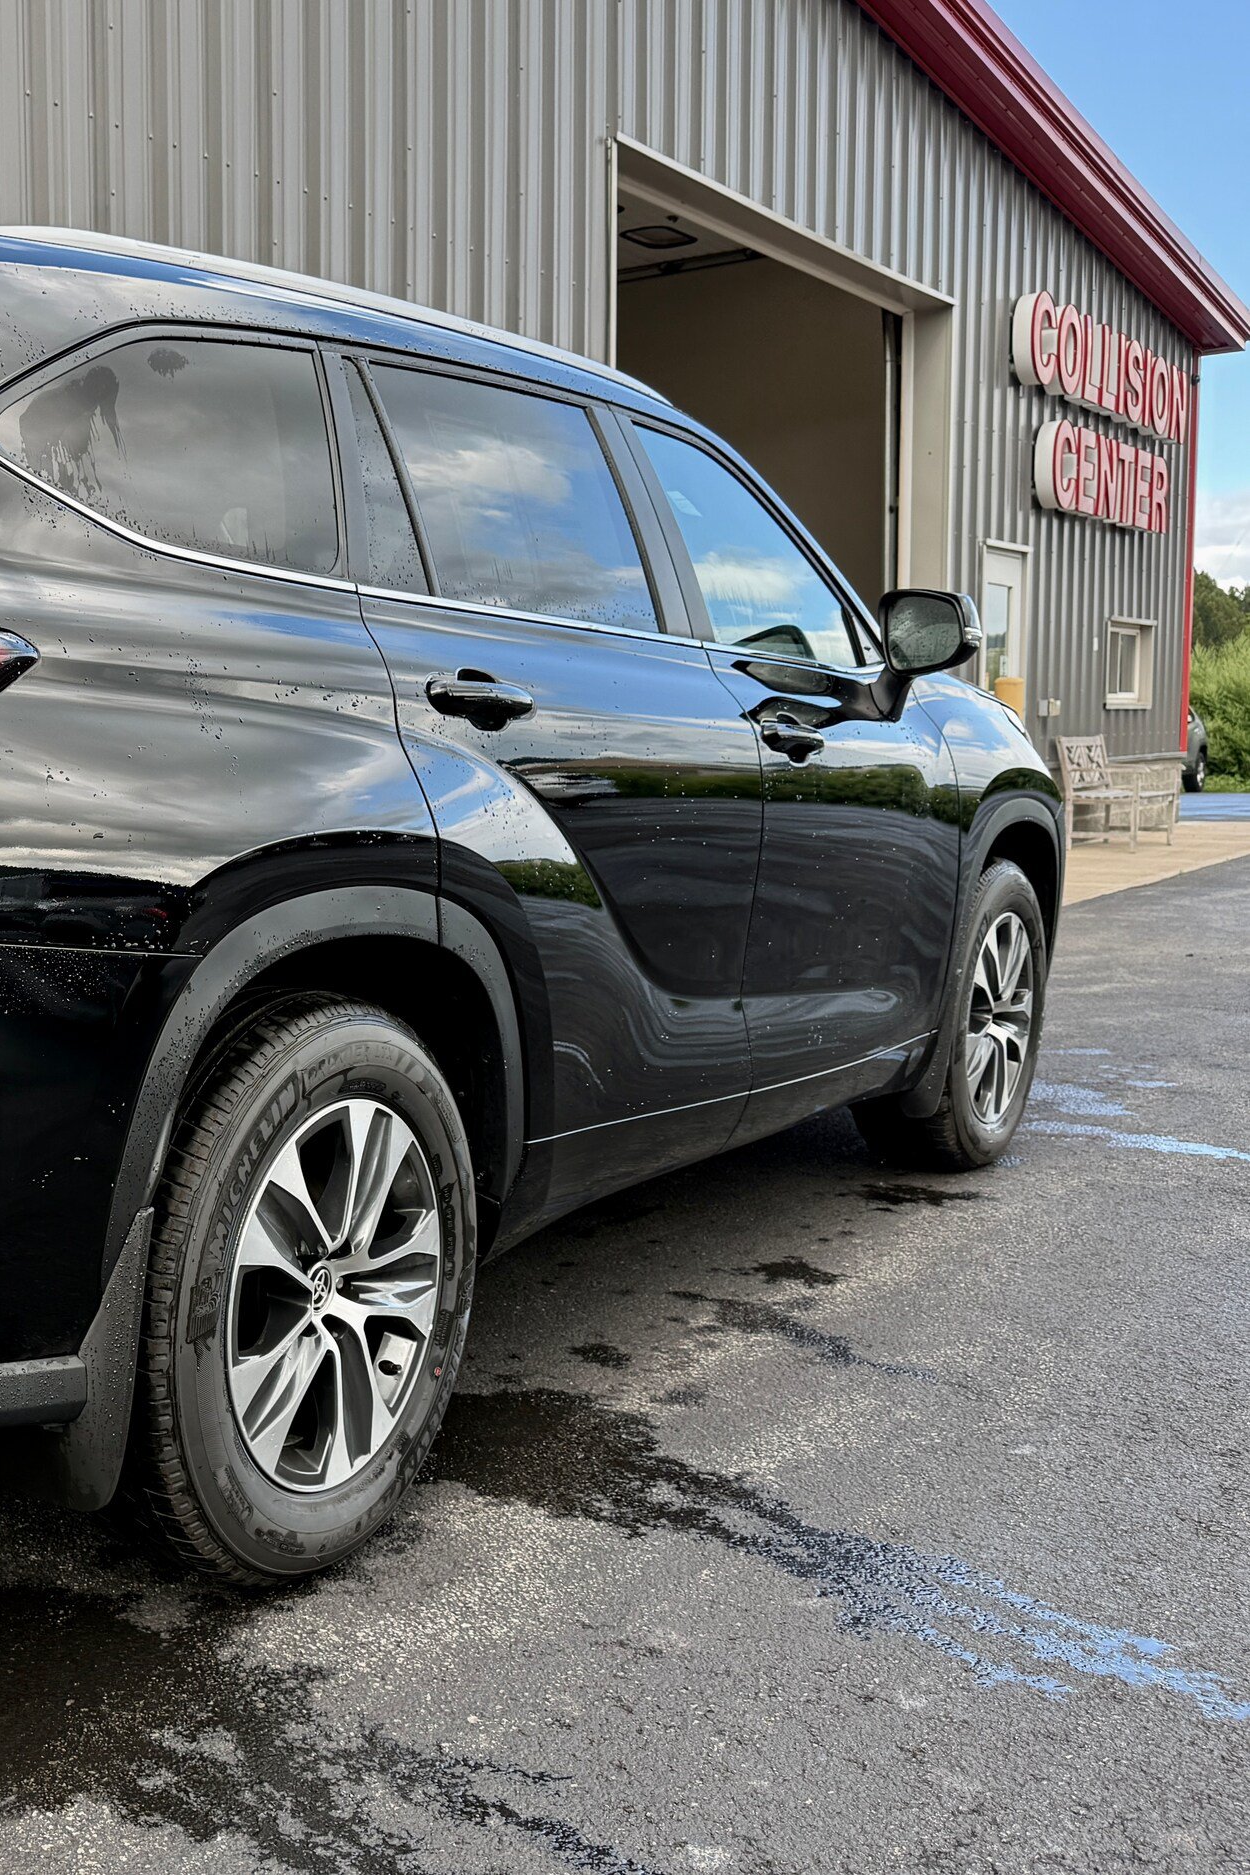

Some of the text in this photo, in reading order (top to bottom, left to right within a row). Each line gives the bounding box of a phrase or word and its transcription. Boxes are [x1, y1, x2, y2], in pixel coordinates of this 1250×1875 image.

[1031, 290, 1187, 445] COLLISION
[1053, 419, 1169, 534] CENTER
[209, 1080, 297, 1262] MICHELIN
